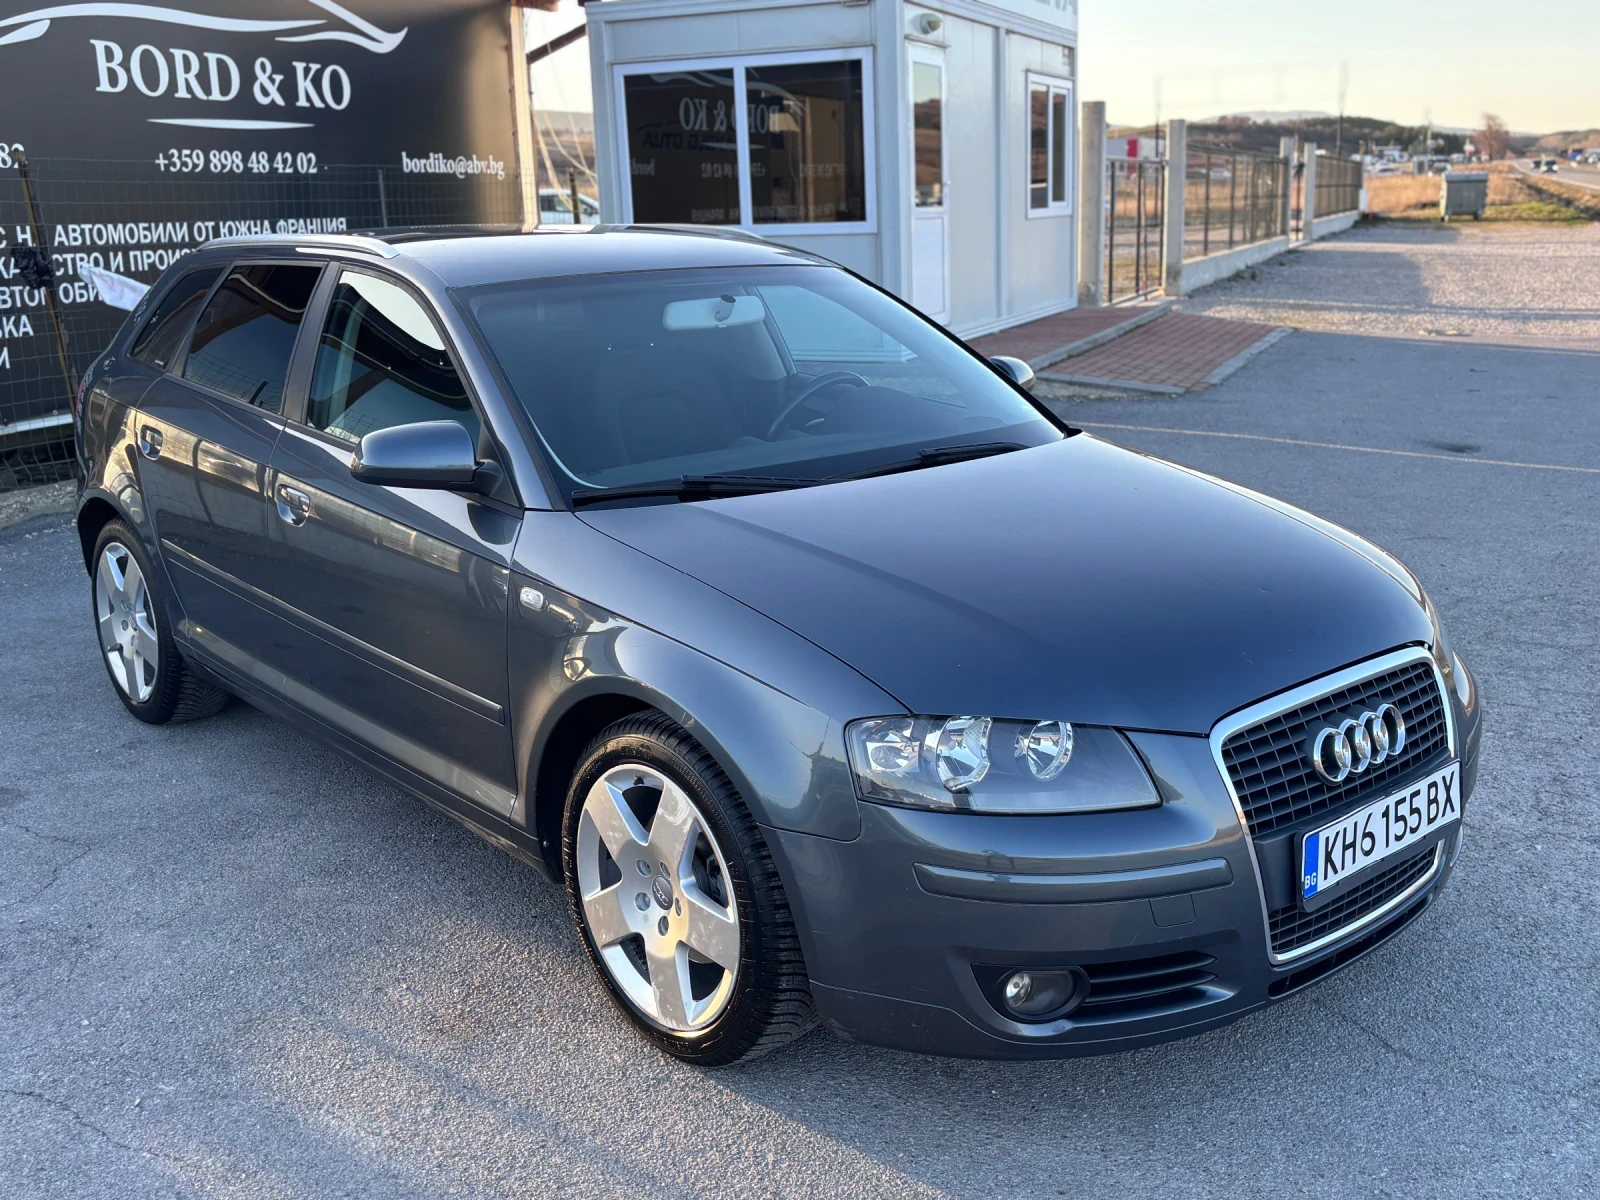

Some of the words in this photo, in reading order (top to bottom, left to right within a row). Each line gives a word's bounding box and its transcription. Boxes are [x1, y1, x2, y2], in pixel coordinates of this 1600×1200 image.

[90, 39, 240, 101] BORD
[253, 57, 285, 106] &
[292, 61, 351, 110] KO
[155, 149, 205, 172] +359
[209, 150, 244, 173] 898
[247, 151, 269, 173] 48
[273, 152, 293, 173] 42
[297, 152, 317, 174] 02
[401, 151, 505, 180] bordiko@abv.bg
[54, 222, 189, 247] АВТОМОБИЛИ
[193, 222, 214, 242] ОТ
[219, 219, 272, 238] ЮЖНА
[109, 251, 124, 273] И
[1304, 871, 1317, 889] BG
